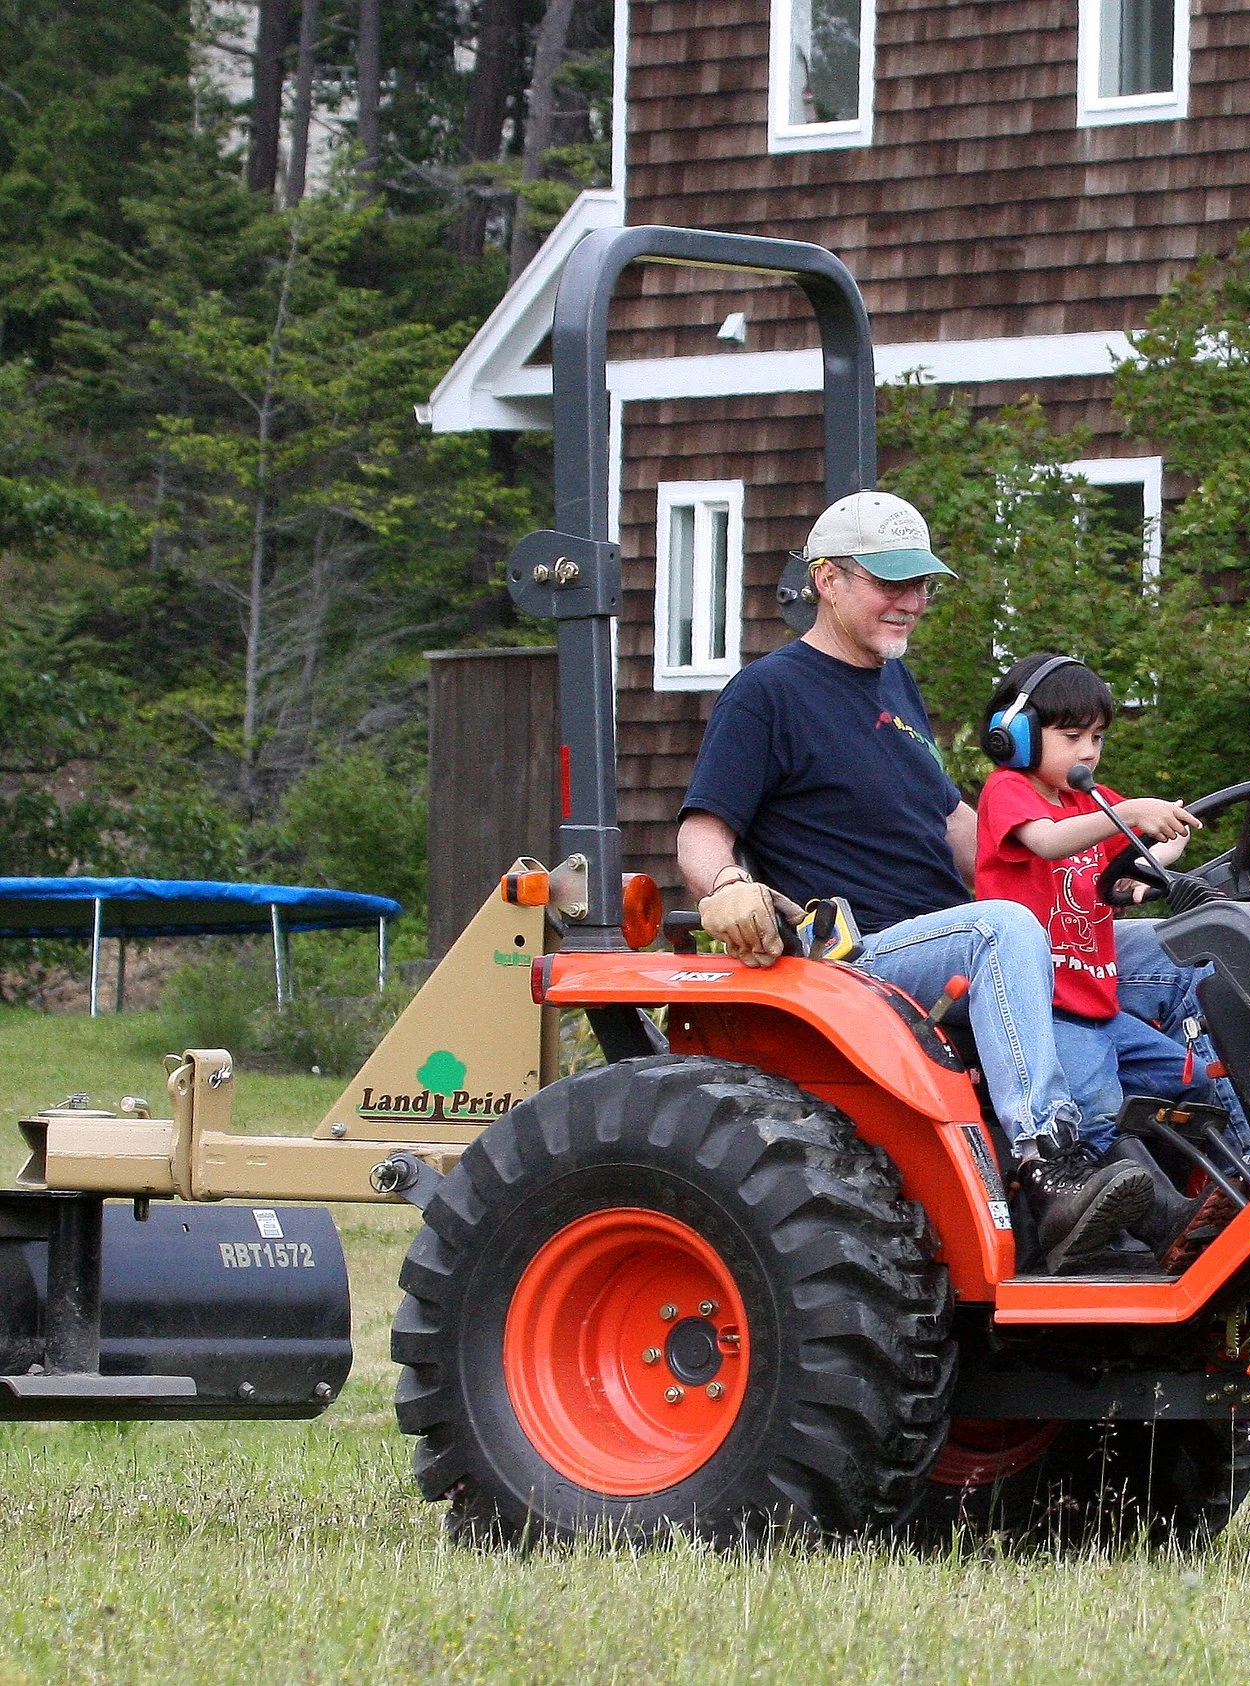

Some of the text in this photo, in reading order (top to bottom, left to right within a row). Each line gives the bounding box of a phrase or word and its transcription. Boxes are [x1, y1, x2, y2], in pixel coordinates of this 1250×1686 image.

[667, 971, 733, 982] HST
[361, 1087, 430, 1113] Land
[218, 1241, 316, 1269] RBT1572
